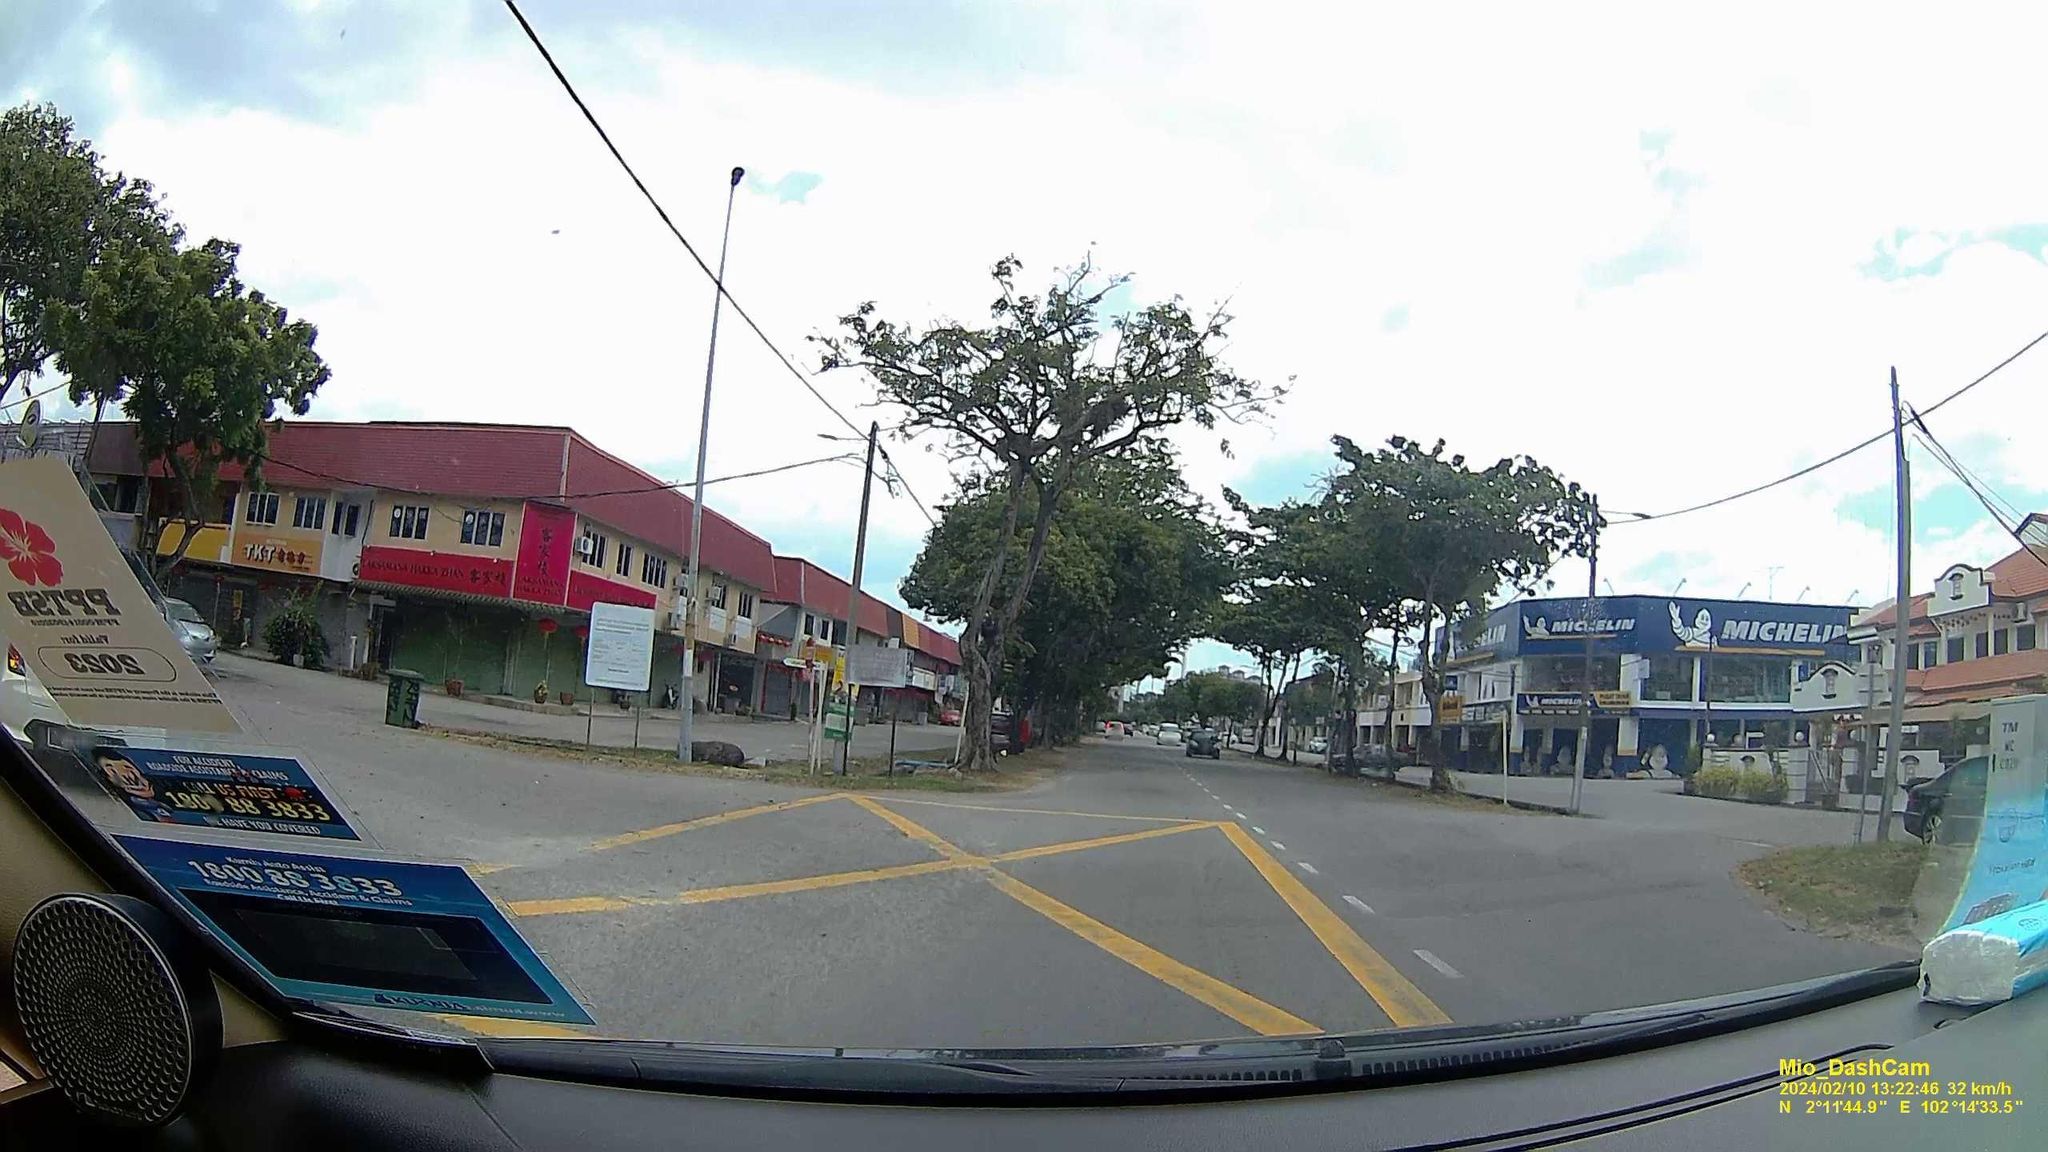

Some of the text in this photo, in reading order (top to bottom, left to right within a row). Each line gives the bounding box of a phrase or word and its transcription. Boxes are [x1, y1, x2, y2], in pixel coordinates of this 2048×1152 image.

[245, 543, 274, 564] TKT
[193, 758, 236, 768] ACCIDENT
[251, 769, 289, 781] CLAIMS
[214, 784, 233, 797] US
[235, 785, 279, 800] FIRST
[225, 797, 261, 815] 88
[262, 800, 331, 821] 3833
[222, 818, 250, 830] HAVE
[249, 820, 272, 831] YOU
[273, 822, 321, 835] COVERED
[262, 859, 290, 870] Auto
[188, 860, 402, 897] 1800 88 3833
[371, 894, 413, 906] Claims
